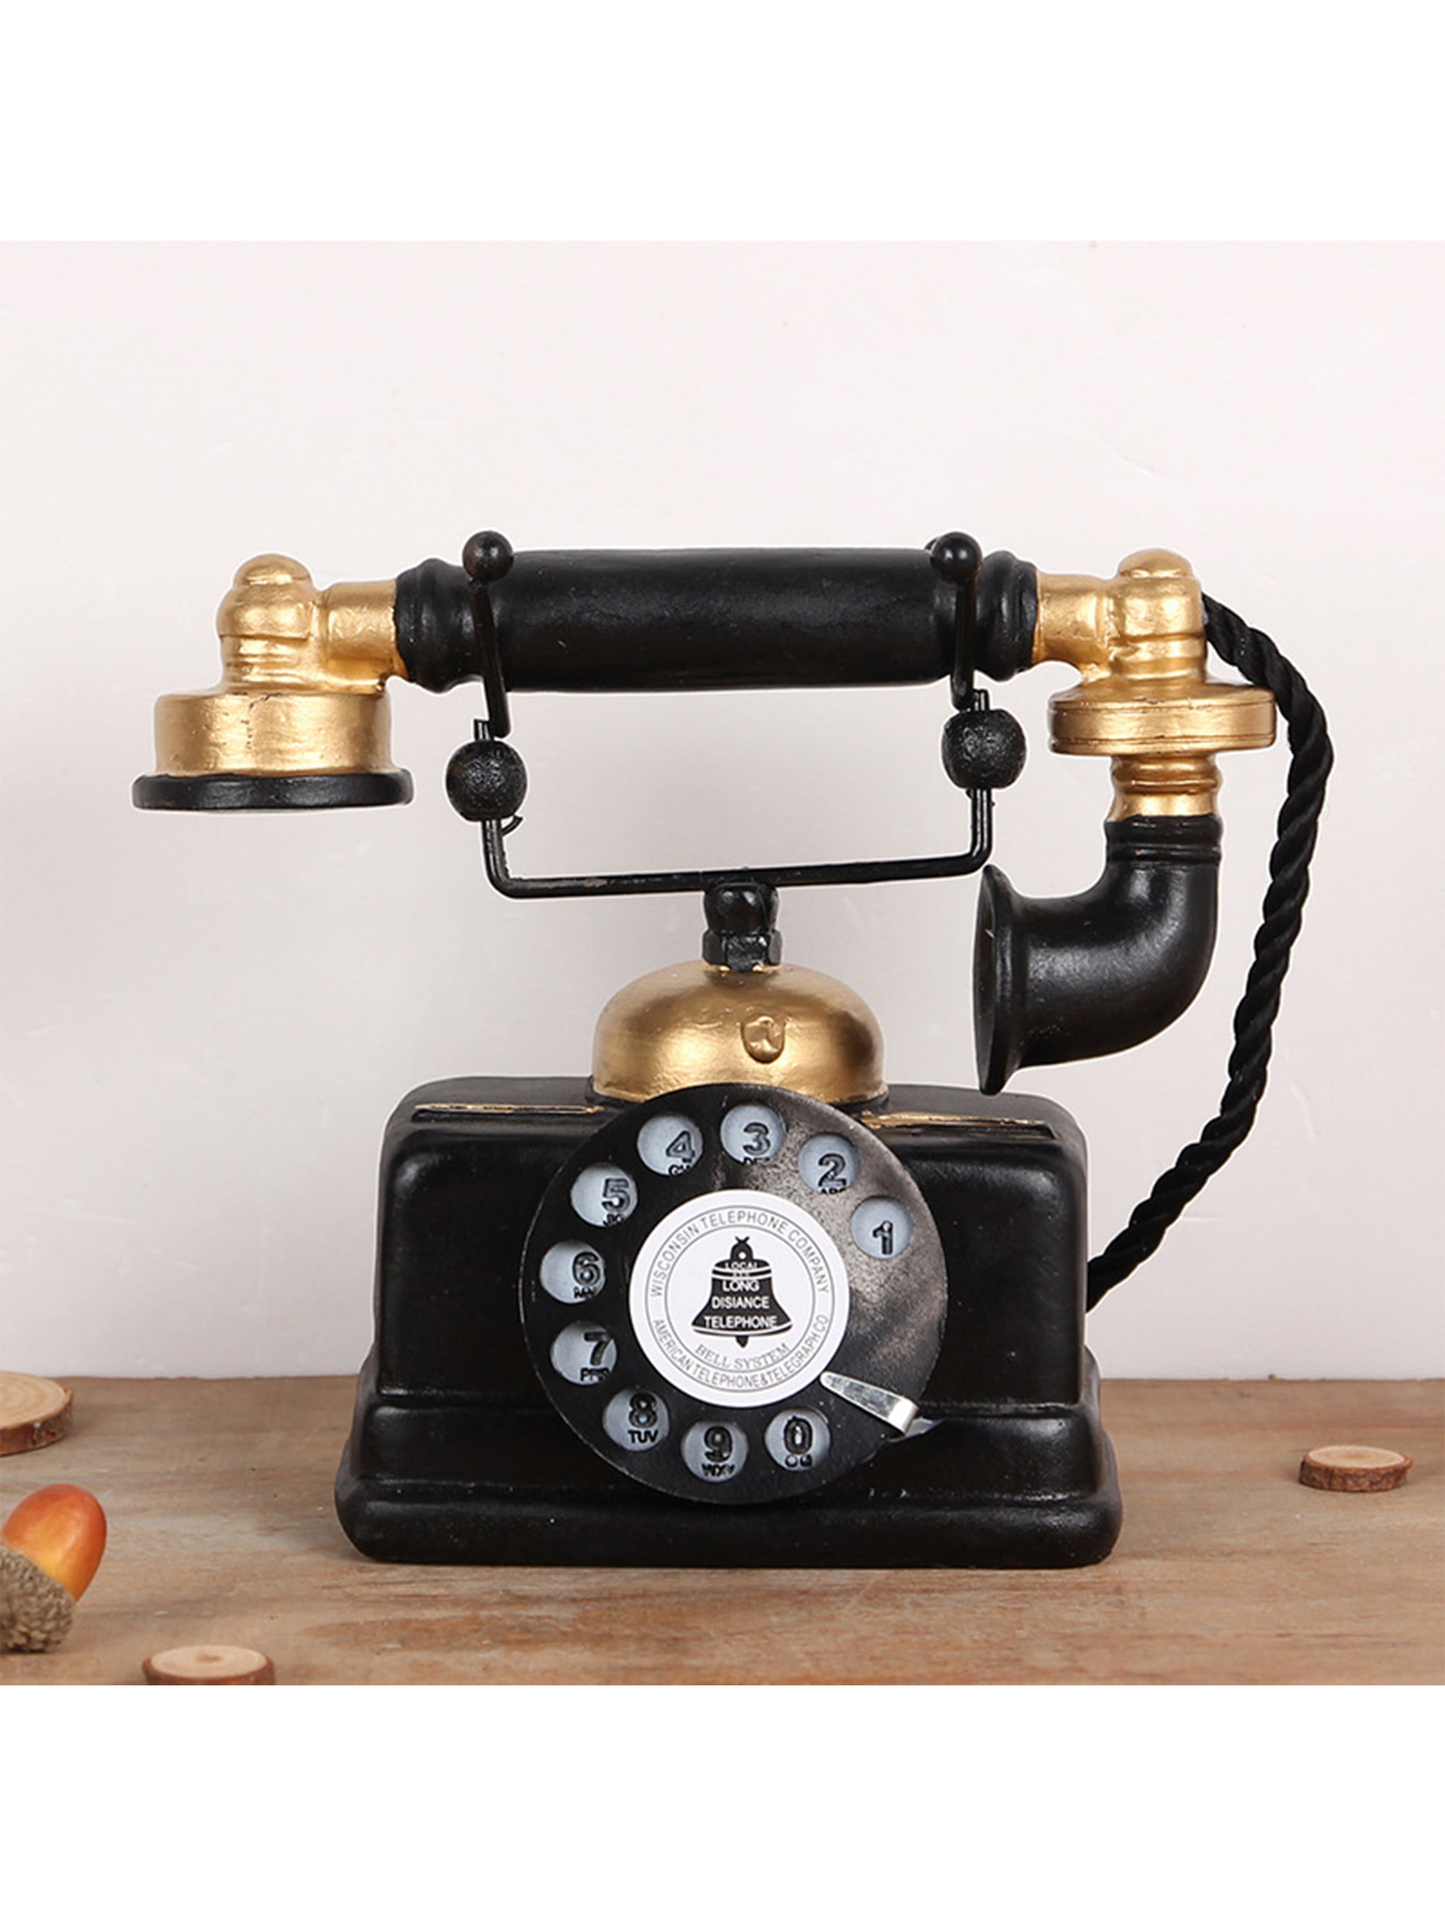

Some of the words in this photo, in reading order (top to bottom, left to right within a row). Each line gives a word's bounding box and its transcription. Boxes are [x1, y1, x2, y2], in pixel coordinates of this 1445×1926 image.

[666, 1130, 696, 1163] 4
[743, 1122, 771, 1156] 3
[818, 1153, 847, 1187] 2
[602, 1178, 631, 1213] 5
[650, 1223, 700, 1298] WISCONSIN
[700, 1209, 788, 1235] TELEPHONE
[787, 1229, 830, 1295] COMPANY
[872, 1221, 893, 1255] 1
[572, 1251, 601, 1286] 6
[722, 1280, 760, 1292] LONG
[703, 1315, 777, 1329] TELEPHONE
[584, 1331, 611, 1366] 7
[653, 1319, 694, 1372] AMERICAN
[695, 1343, 731, 1369] BELL
[733, 1342, 791, 1369] SYSTEM
[628, 1393, 659, 1428] 8
[628, 1430, 659, 1443] TUV
[703, 1425, 733, 1463] 9
[783, 1416, 813, 1455] 0
